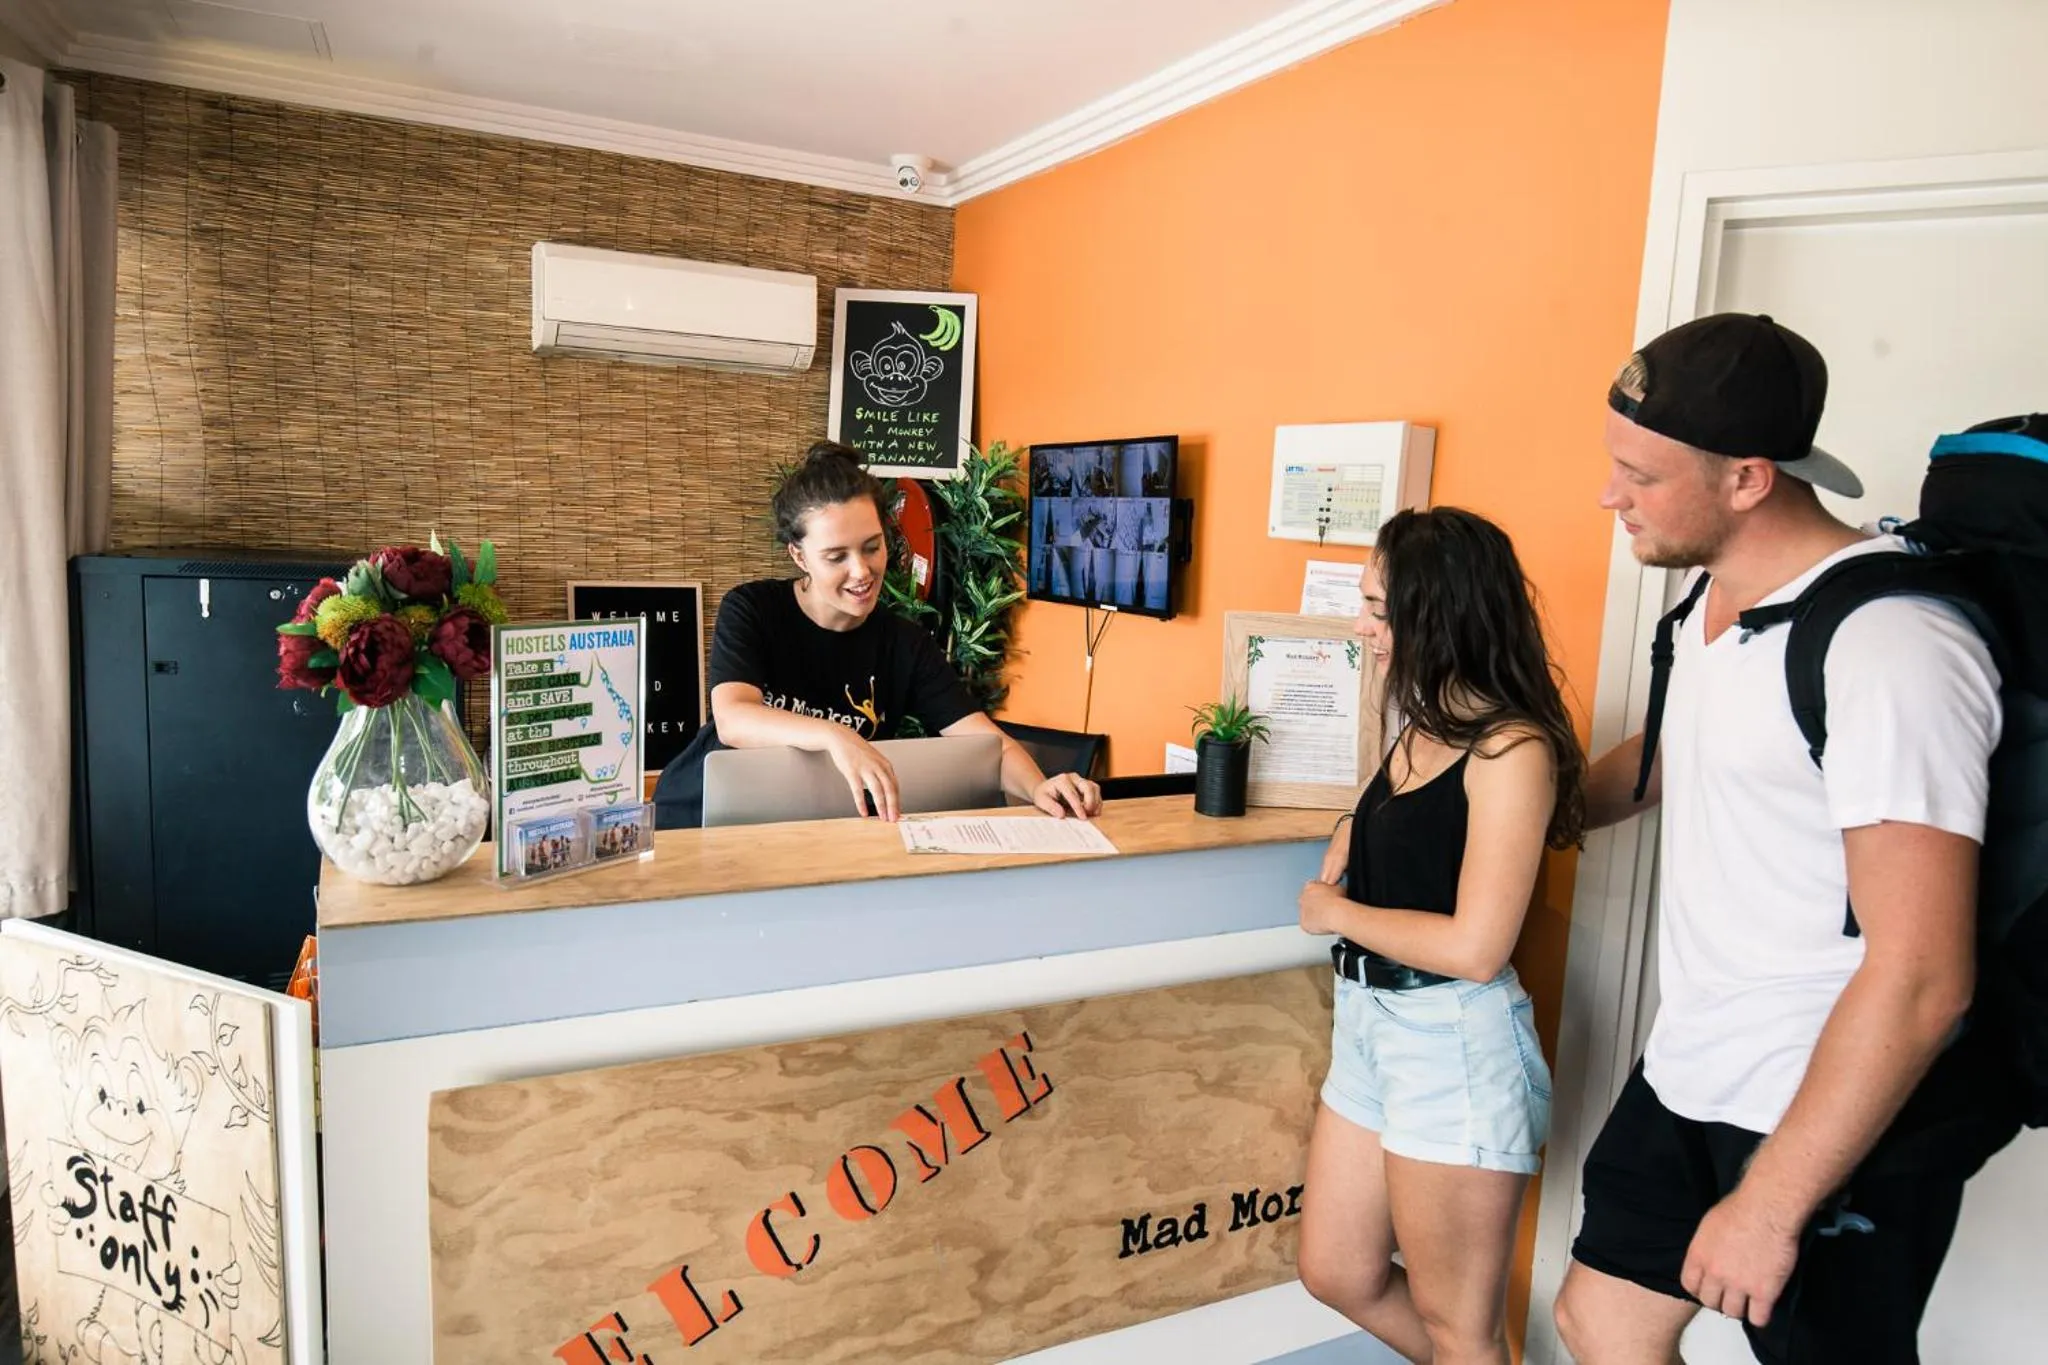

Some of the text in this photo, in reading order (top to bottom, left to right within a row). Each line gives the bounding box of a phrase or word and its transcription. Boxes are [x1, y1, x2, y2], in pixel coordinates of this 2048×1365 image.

[855, 407, 940, 423] SMILE LIKE
[864, 424, 934, 437] A MONKEY
[852, 439, 937, 451] WITH A NEW
[505, 629, 635, 655] HOSTELS AUSTRALIA
[506, 661, 552, 675] Take a
[507, 690, 570, 707] and SAVE
[763, 690, 786, 709] ad
[507, 725, 550, 741] at the
[506, 753, 578, 773] throughout
[61, 1152, 178, 1252] Staff
[1118, 1203, 1209, 1259] Mad
[100, 1235, 187, 1314] only
